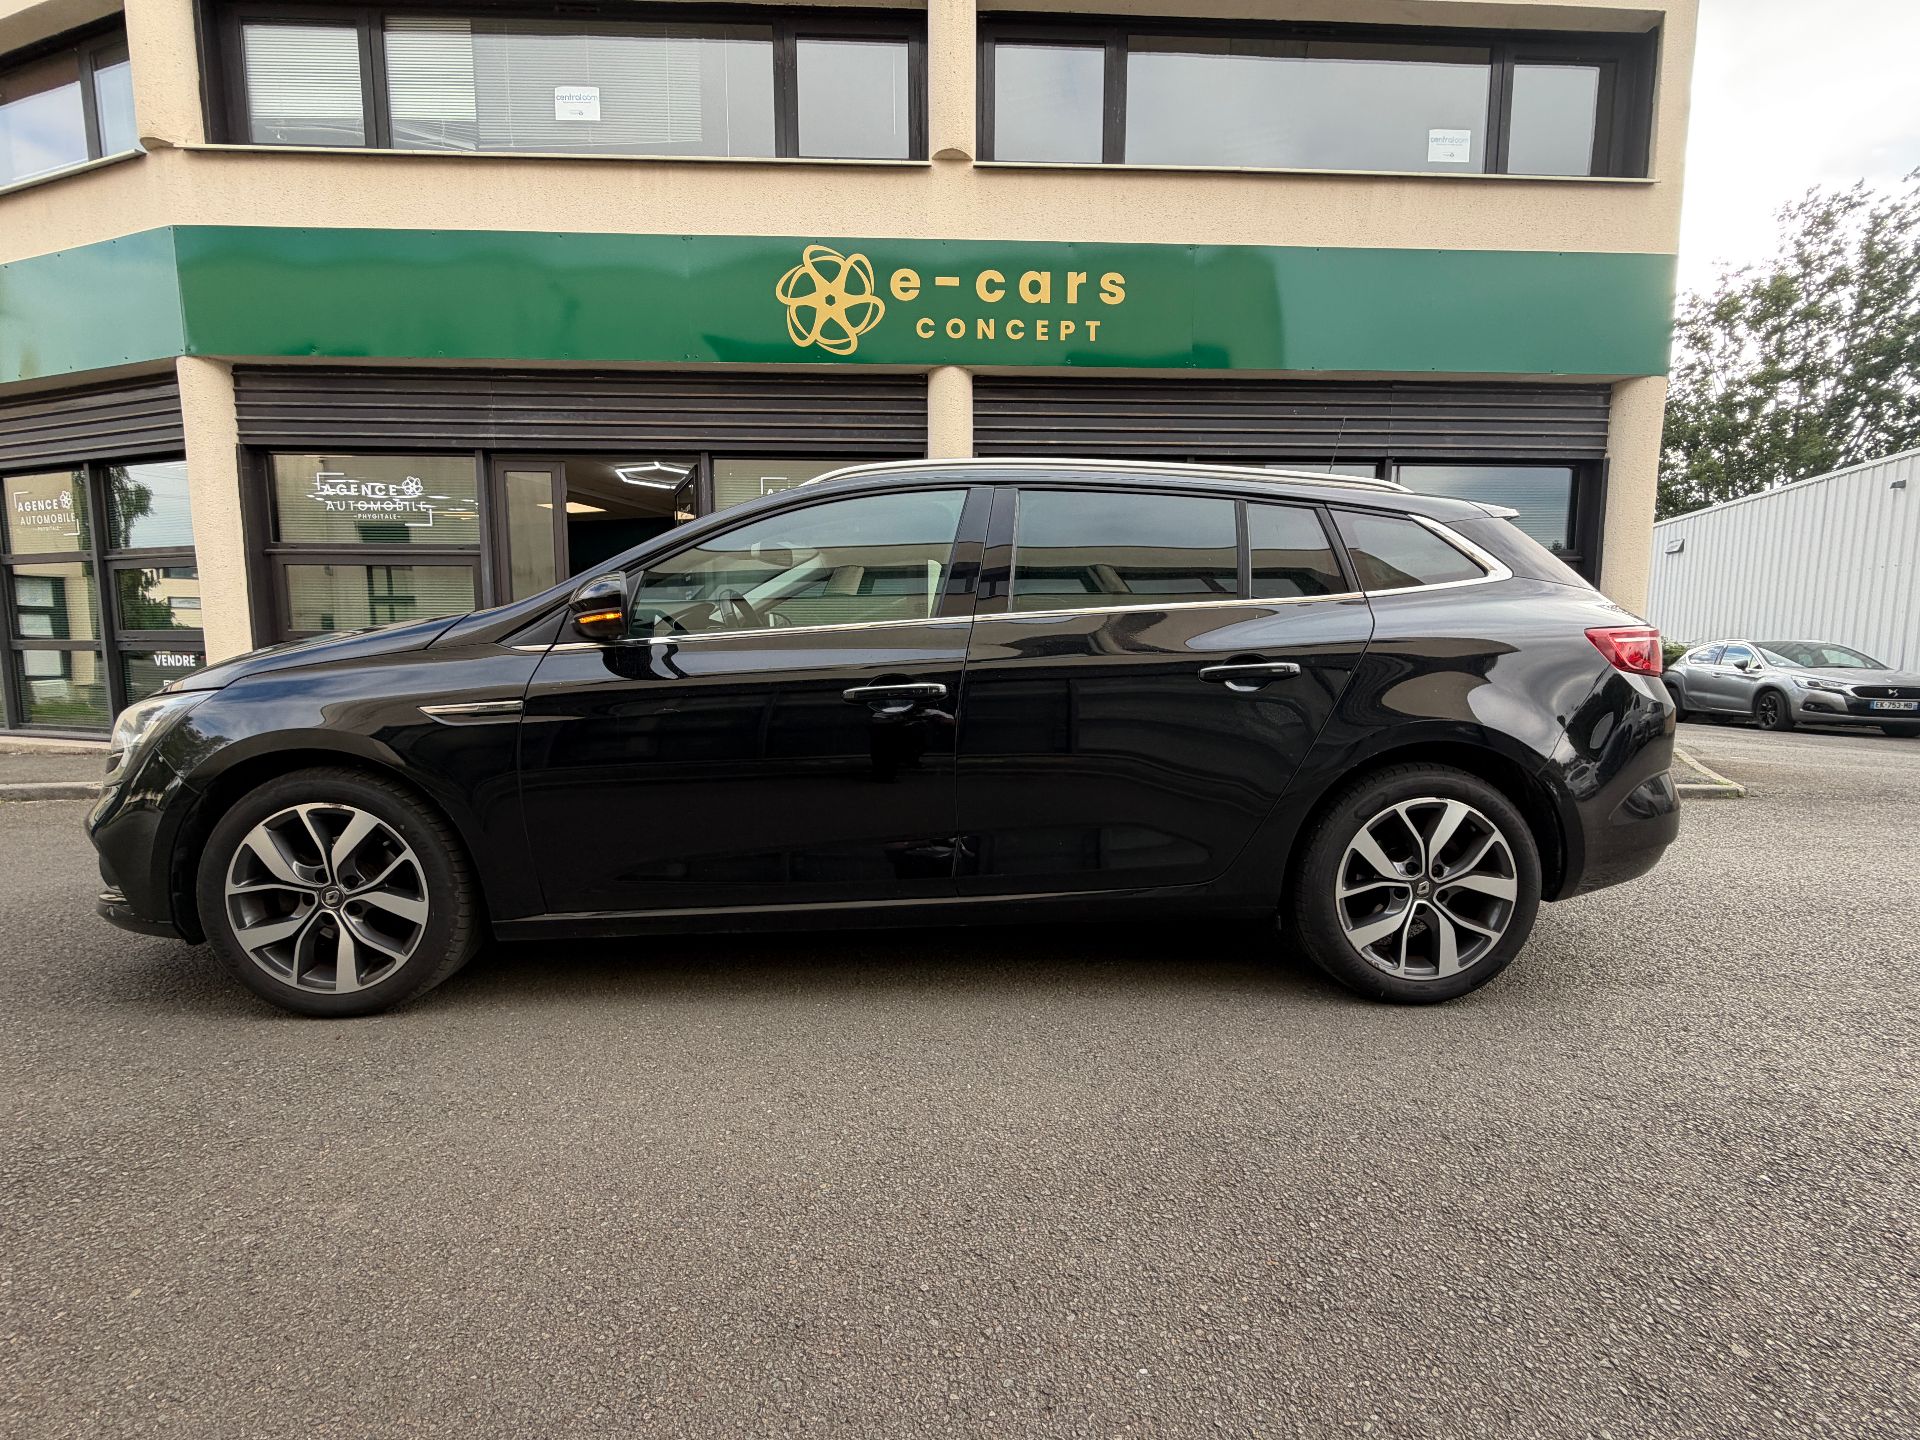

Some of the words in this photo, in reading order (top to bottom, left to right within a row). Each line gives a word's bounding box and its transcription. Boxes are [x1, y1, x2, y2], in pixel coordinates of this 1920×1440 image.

[915, 317, 1101, 342] CONCEPT
[322, 484, 398, 496] AGENCE
[18, 499, 59, 512] AGENCE
[326, 500, 427, 512] AUTOMOBILE
[20, 512, 76, 526] AUTOMOBILE
[153, 654, 196, 667] VENDRE
